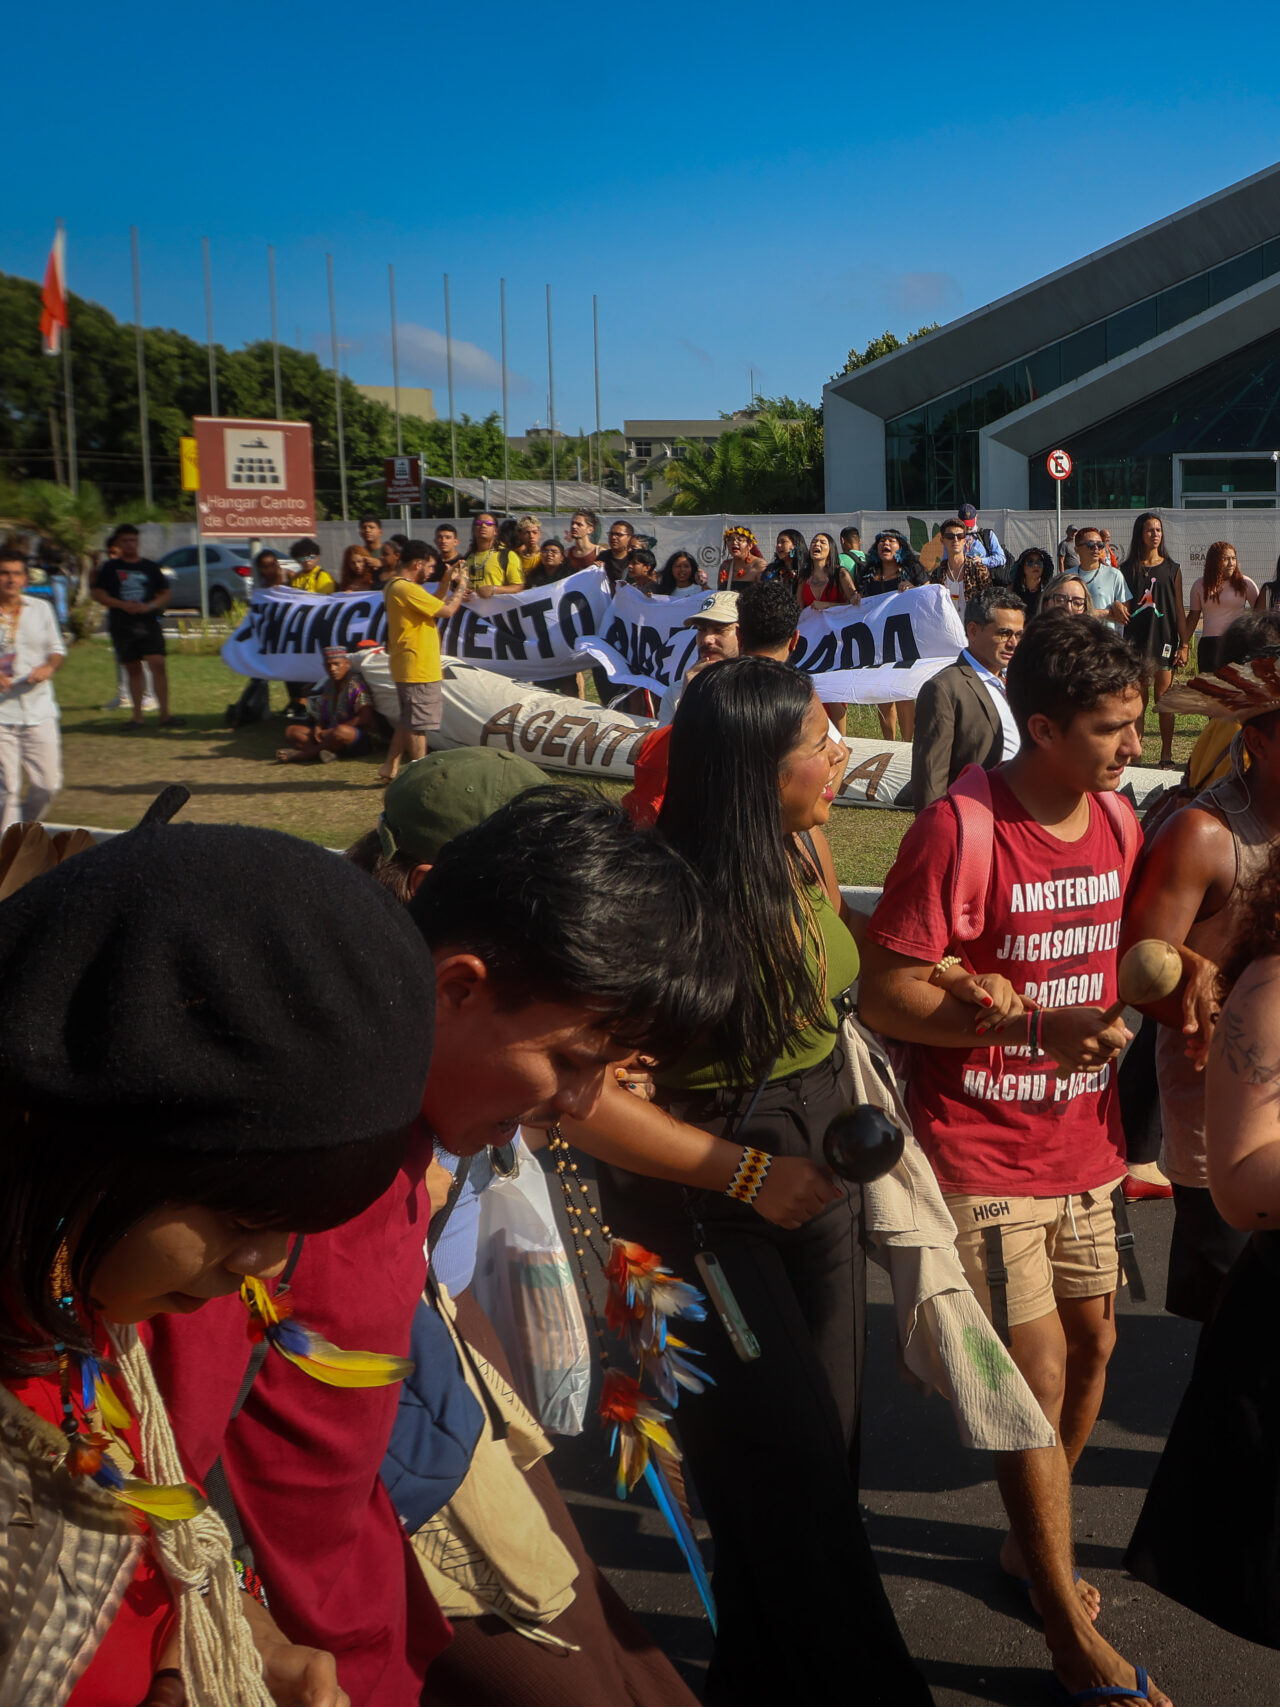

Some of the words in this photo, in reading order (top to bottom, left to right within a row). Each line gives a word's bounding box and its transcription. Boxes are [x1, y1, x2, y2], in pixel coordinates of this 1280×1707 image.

[206, 495, 257, 513] Hangar
[260, 495, 307, 511] Centro
[204, 514, 222, 527] de
[225, 513, 313, 530] Convenções
[1010, 868, 1120, 913] AMSTERDAM
[963, 1069, 1047, 1101] MACHU
[973, 1201, 1010, 1222] HIGH
